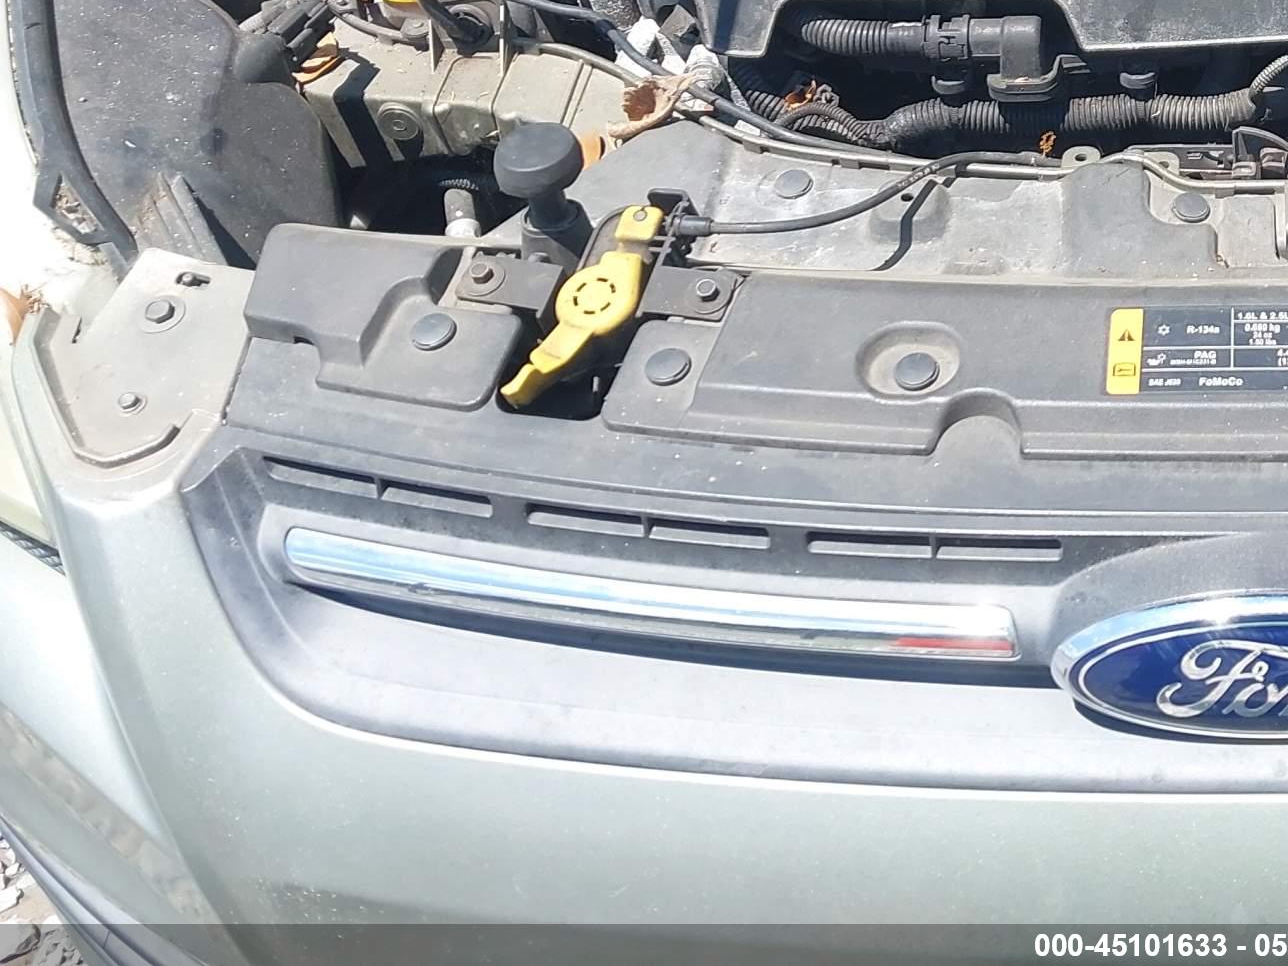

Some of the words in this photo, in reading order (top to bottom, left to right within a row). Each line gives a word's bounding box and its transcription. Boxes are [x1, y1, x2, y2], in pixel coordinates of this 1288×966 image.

[1259, 311, 1268, 320] &
[1186, 324, 1220, 334] R-134a
[1268, 322, 1281, 333] kg
[1194, 350, 1217, 359] PAG
[1198, 376, 1244, 387] FoMoCo
